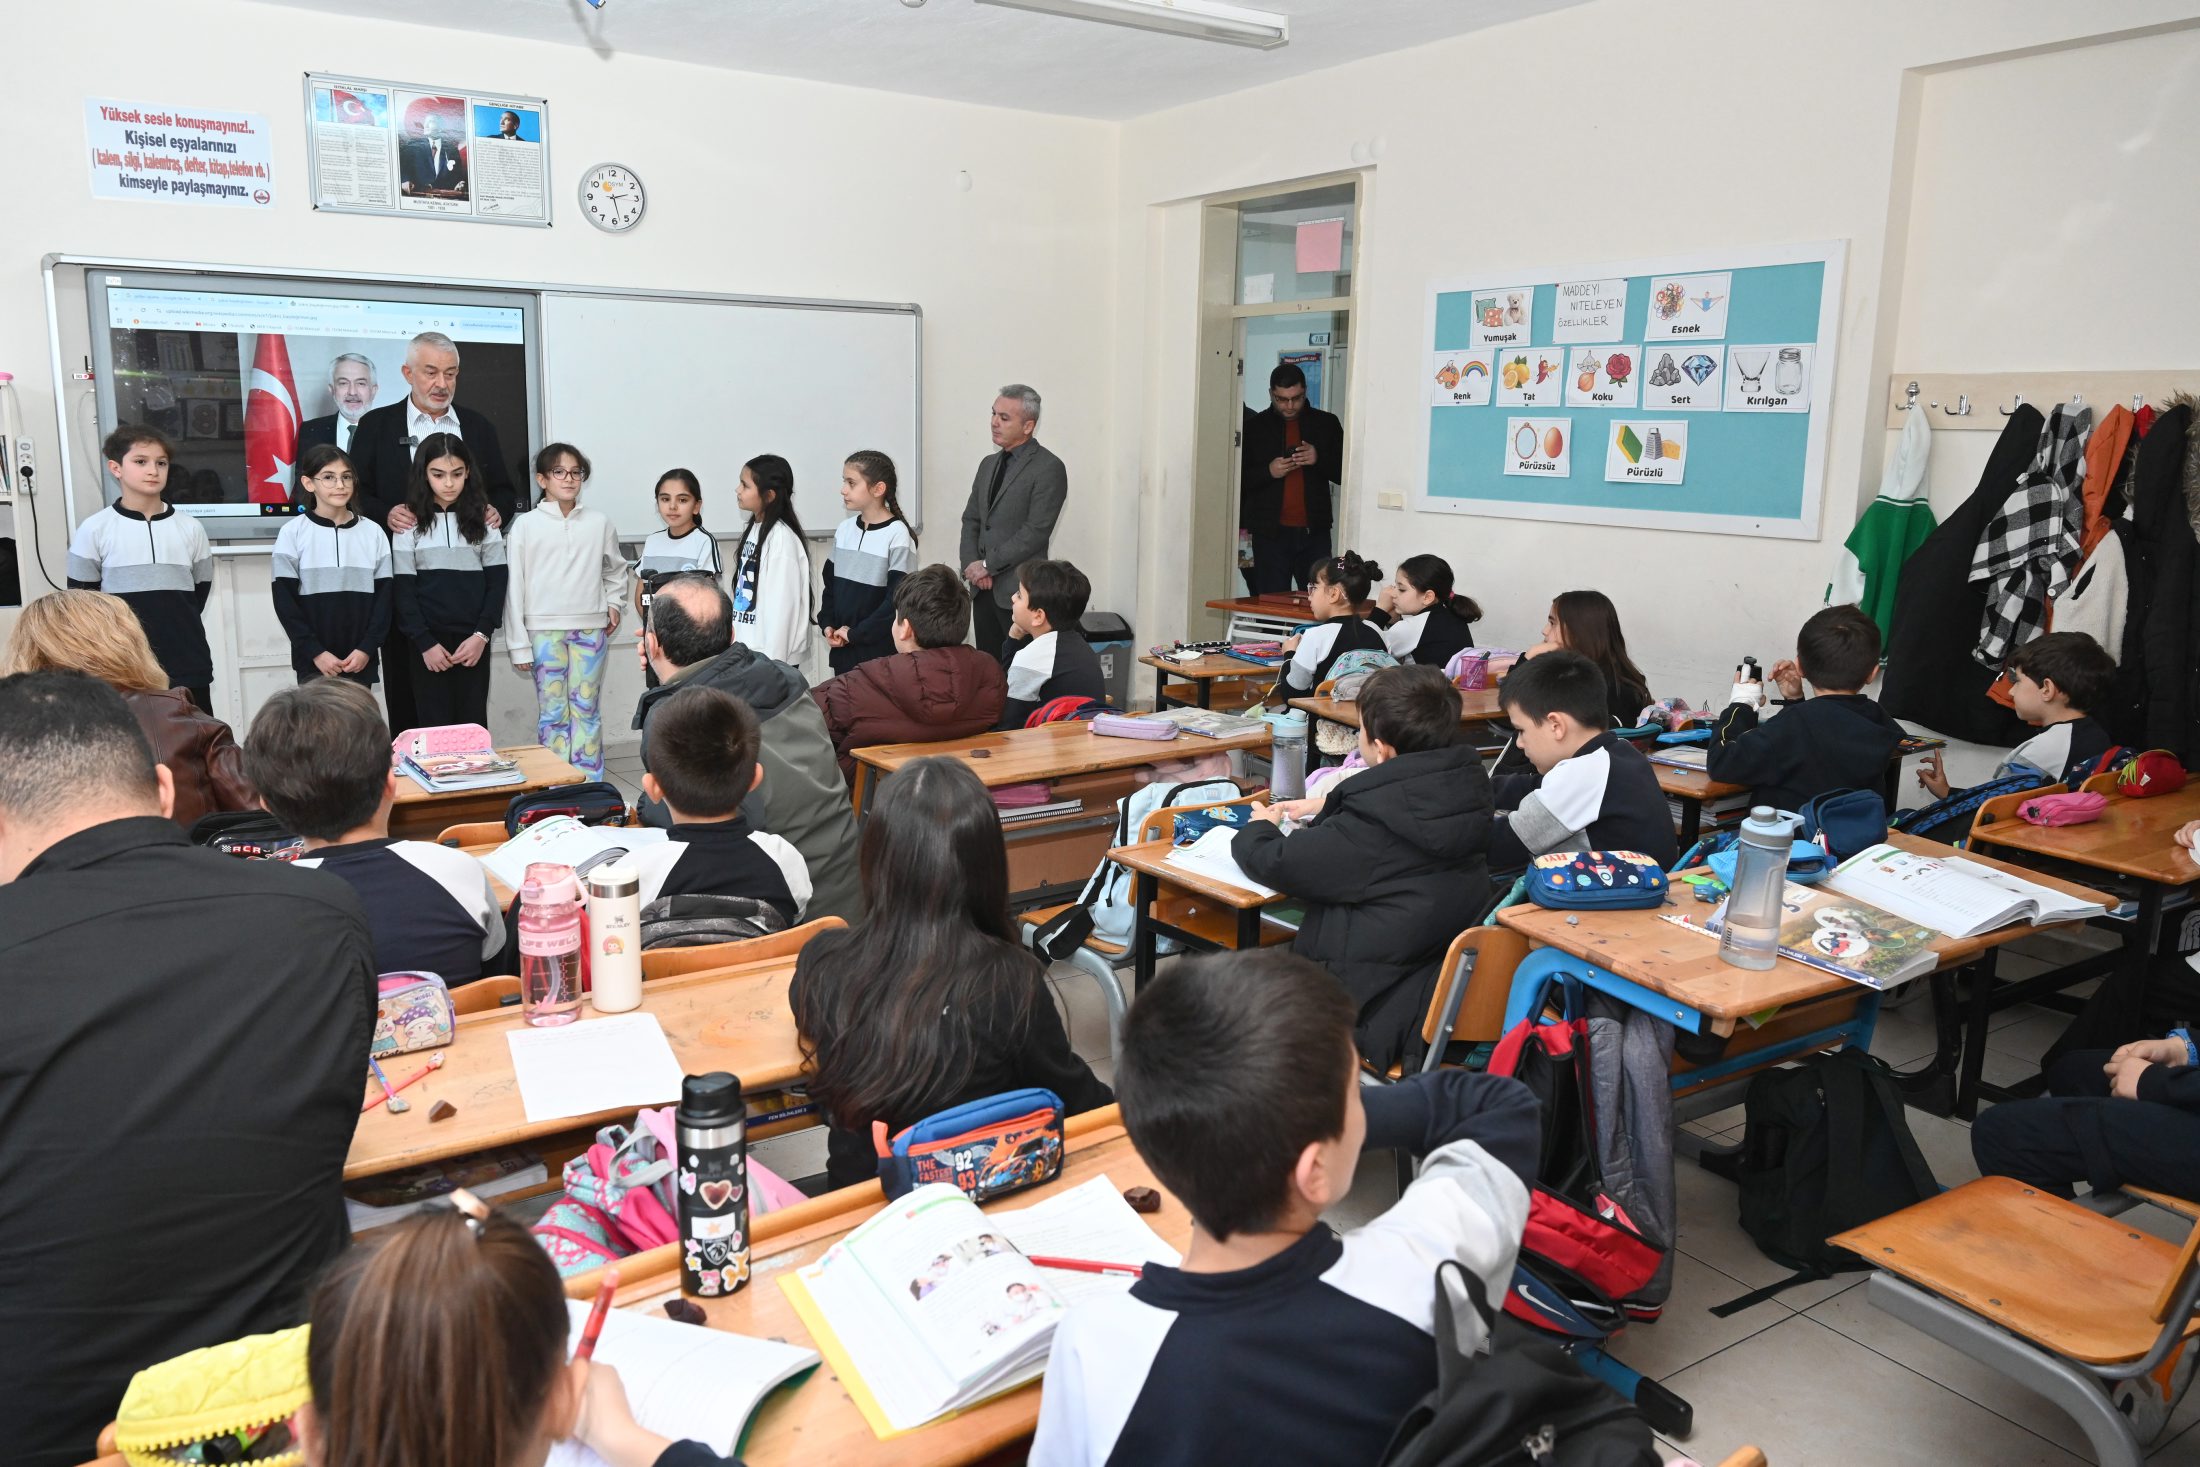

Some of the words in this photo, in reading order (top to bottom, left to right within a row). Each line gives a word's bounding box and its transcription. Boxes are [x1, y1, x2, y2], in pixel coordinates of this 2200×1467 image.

[100, 105, 142, 124] Yüksek
[144, 112, 173, 127] sesle
[125, 129, 167, 149] Kişisel
[170, 136, 237, 154] eşyalarınızı
[97, 148, 123, 170] kalem,
[184, 156, 208, 177] defter,
[598, 172, 604, 180] 11
[608, 169, 617, 177] 12
[119, 173, 168, 191] kimseyle
[171, 178, 249, 199] paylaşmayınız.
[591, 180, 600, 188] 10
[629, 182, 635, 190] 2
[591, 205, 598, 213] 8
[611, 217, 618, 225] 6
[1671, 323, 1701, 335] Esnek
[1483, 332, 1517, 343] Yumuşak
[1453, 391, 1472, 401] Renk
[1523, 392, 1536, 401] Tat
[1591, 392, 1614, 402] Koku
[1671, 395, 1691, 404] Sert
[1746, 396, 1788, 408] Kırılgan
[1519, 460, 1556, 472] Pürüzsüz
[1626, 466, 1664, 478] Pürüzlü
[520, 936, 543, 949] LIFE
[547, 933, 577, 948] WELL
[916, 1159, 937, 1171] THE
[954, 1150, 974, 1171] 92
[918, 1167, 953, 1182] FASTEST
[957, 1171, 977, 1191] 93
